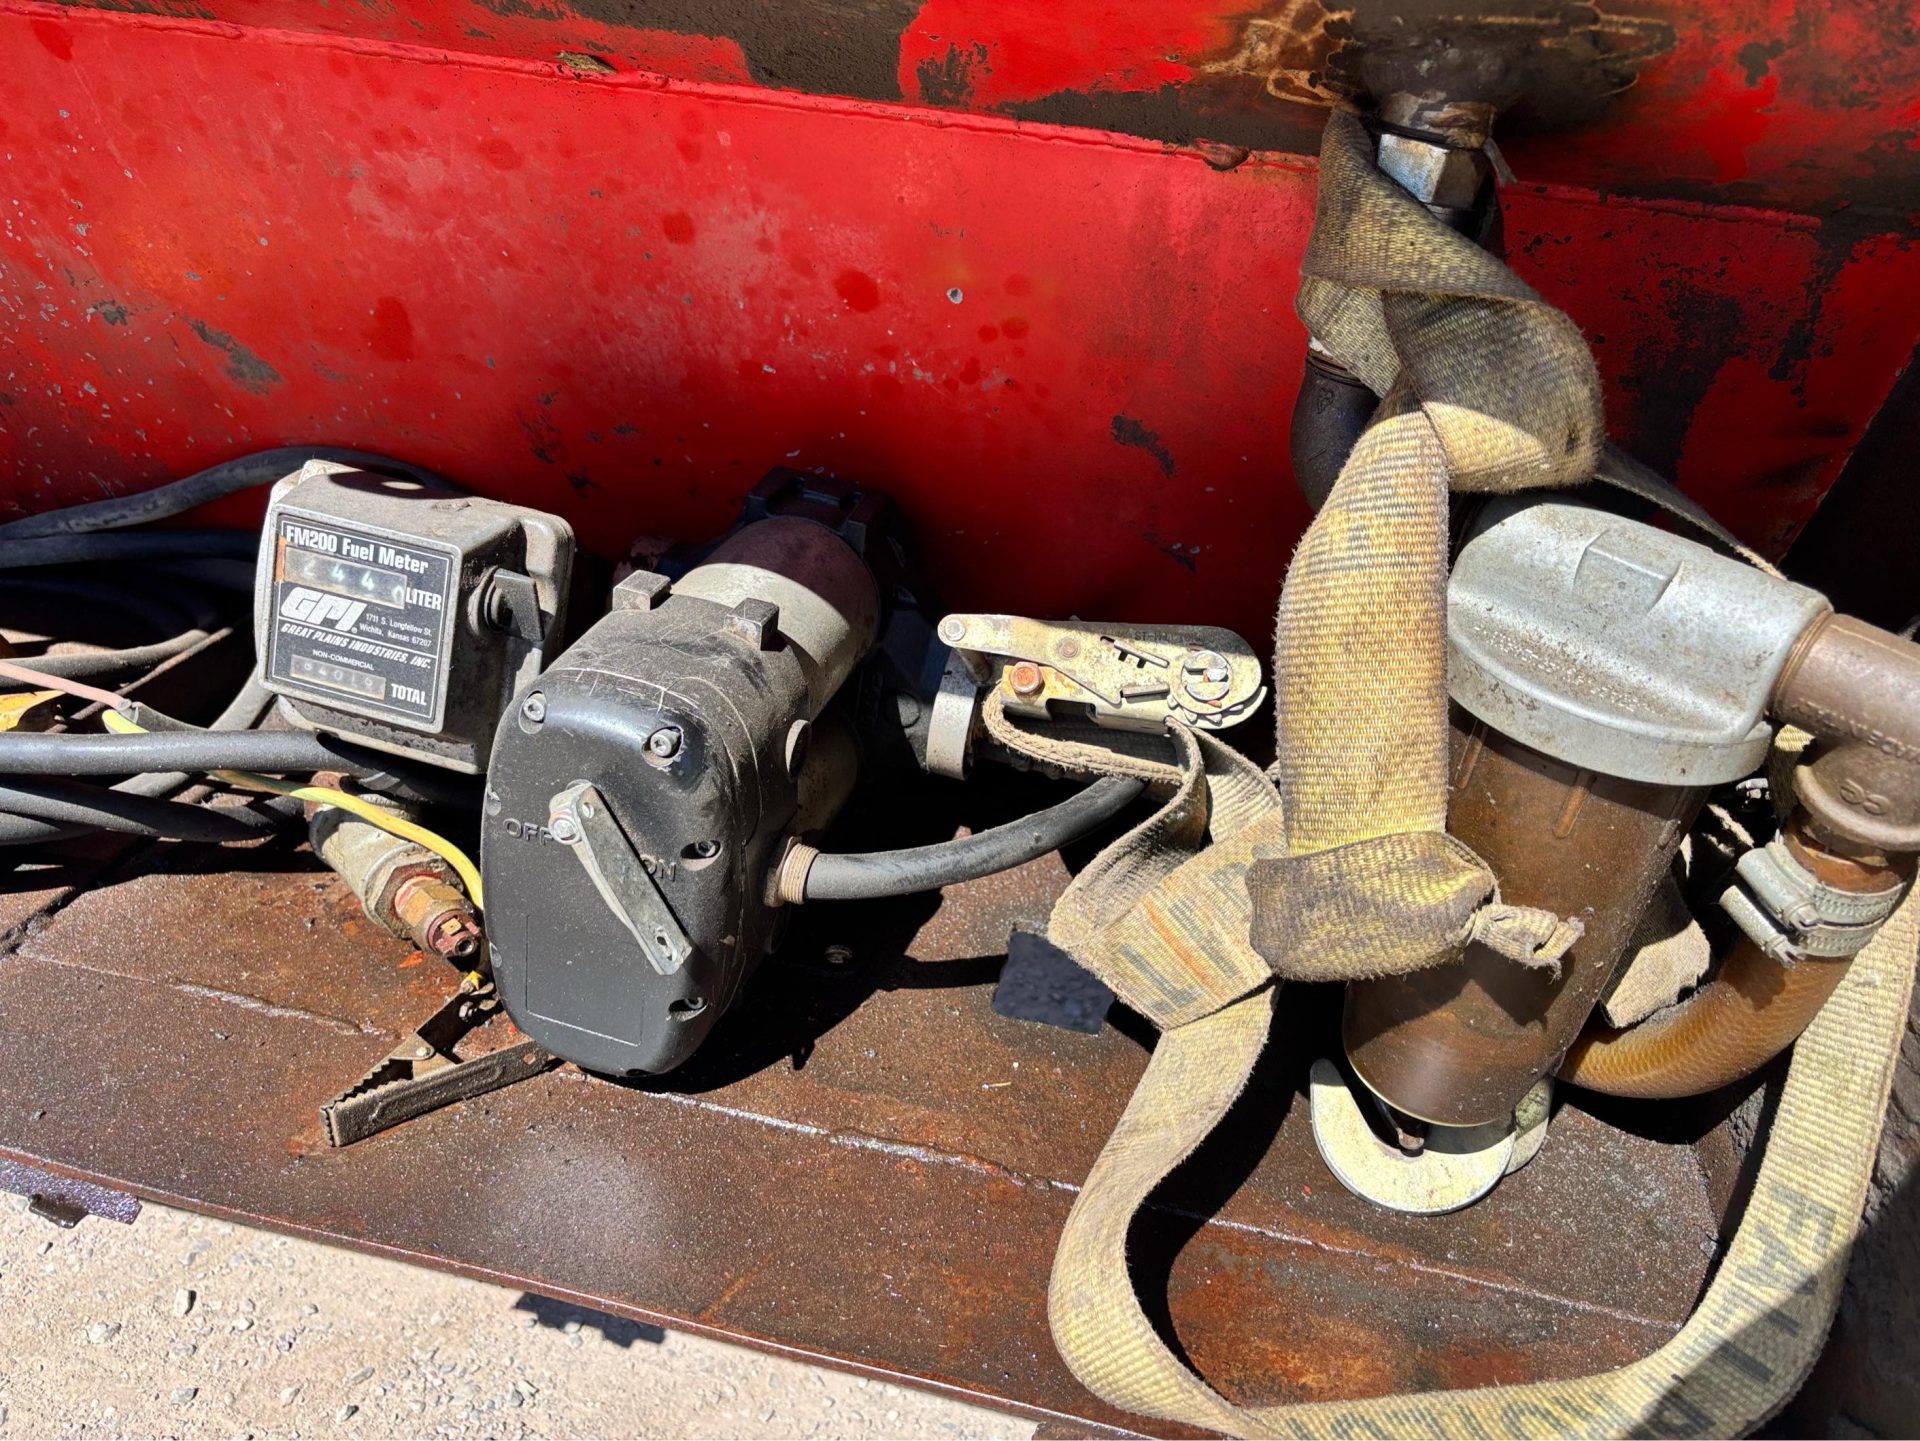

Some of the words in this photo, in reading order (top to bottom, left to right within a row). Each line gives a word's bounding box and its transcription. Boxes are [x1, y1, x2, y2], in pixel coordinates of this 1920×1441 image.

[285, 525, 338, 553] FM200
[342, 537, 375, 562] Fuel
[378, 546, 428, 574] Meter
[281, 586, 368, 632] GPI
[405, 586, 442, 611] LITER
[359, 622, 384, 637] Wichita,
[388, 630, 410, 643] Kansas
[412, 636, 432, 648] 67207
[366, 613, 379, 623] 1711
[381, 616, 388, 625] S.
[390, 619, 423, 635] Longfellow
[424, 627, 433, 637] St.
[281, 622, 315, 639] GREAT
[311, 630, 350, 648] PLAINS
[410, 655, 432, 669] INC.
[312, 649, 375, 671] NON-COMMERCIAL
[391, 683, 427, 706] TOTAL
[503, 817, 553, 846] OFF
[640, 853, 677, 882] ON
